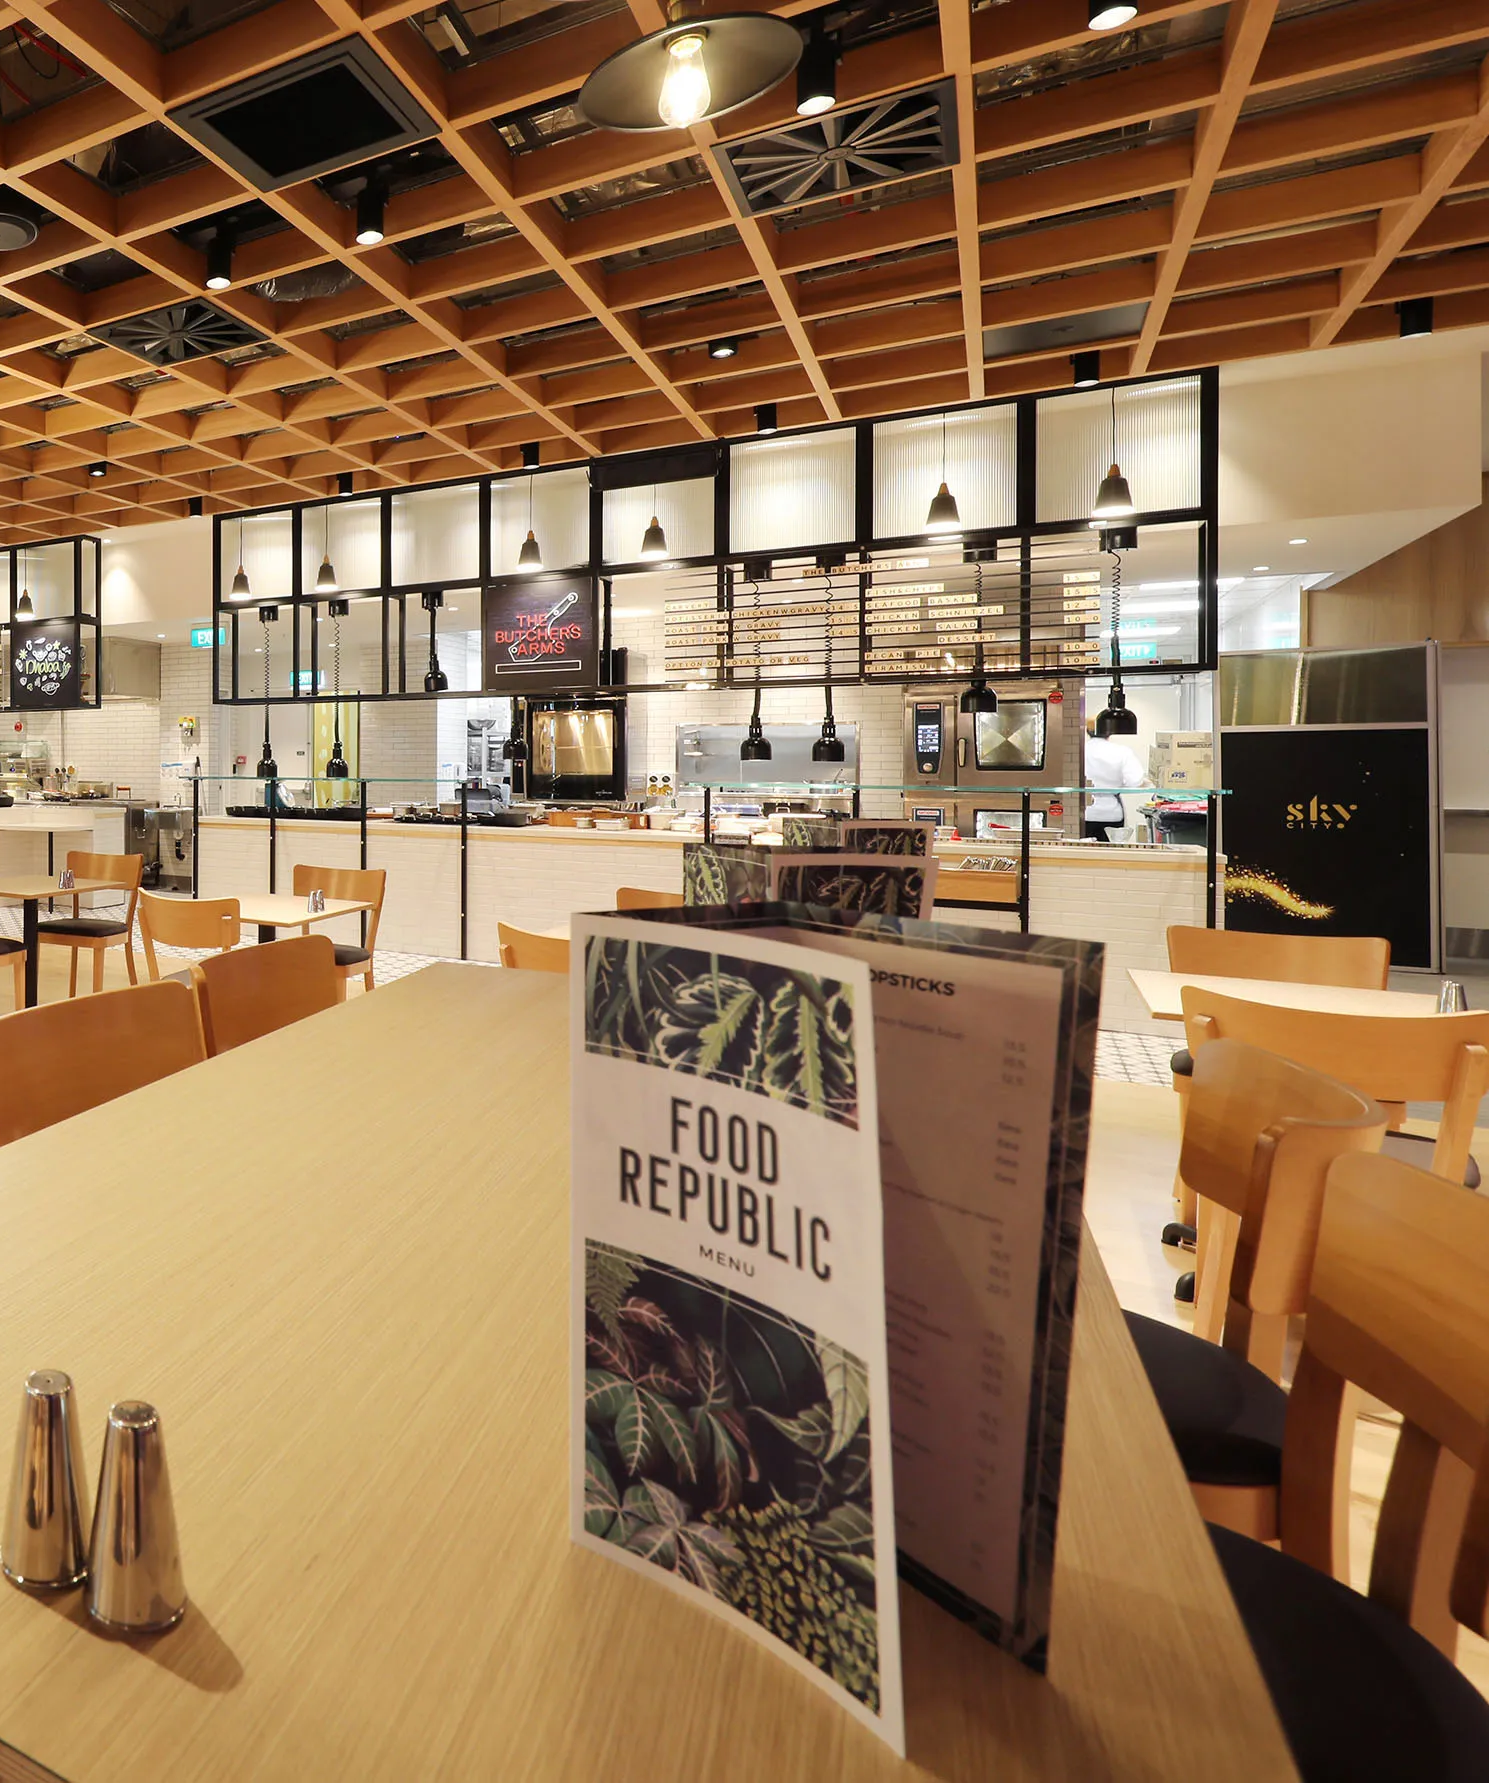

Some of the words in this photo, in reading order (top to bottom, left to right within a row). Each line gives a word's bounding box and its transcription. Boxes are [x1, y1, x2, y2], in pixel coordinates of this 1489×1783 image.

[831, 562, 891, 575] BUTCHERS
[665, 602, 710, 612] CARVERY
[866, 598, 920, 609] SEAFOOD
[929, 595, 976, 605] BASKET
[516, 612, 548, 628] THE
[866, 612, 919, 622] CHICKEN
[930, 606, 1002, 618] SCHNITZEL
[665, 626, 696, 635] ROAST
[702, 624, 728, 632] BEEF
[746, 620, 780, 630] GRAVY
[866, 625, 919, 634] CHICKEN
[937, 621, 977, 631] SALAD
[665, 638, 696, 646] ROAST
[702, 636, 728, 644] PORK
[746, 632, 780, 642] GRAVY
[938, 633, 994, 643] DESSERT
[516, 640, 566, 656] ARMS
[866, 650, 904, 659] PECAN
[916, 649, 940, 657] PIE
[665, 660, 703, 669] OPTION
[725, 657, 765, 667] POTATO
[788, 655, 810, 664] VEG
[866, 662, 926, 672] TIRAMISU
[1286, 795, 1358, 821] sky
[1286, 822, 1332, 830] CITY
[870, 968, 955, 997] OPSTICKS
[671, 1096, 779, 1186] FOOD
[619, 1145, 832, 1283] REPUBLIC
[699, 1244, 756, 1278] MENU
